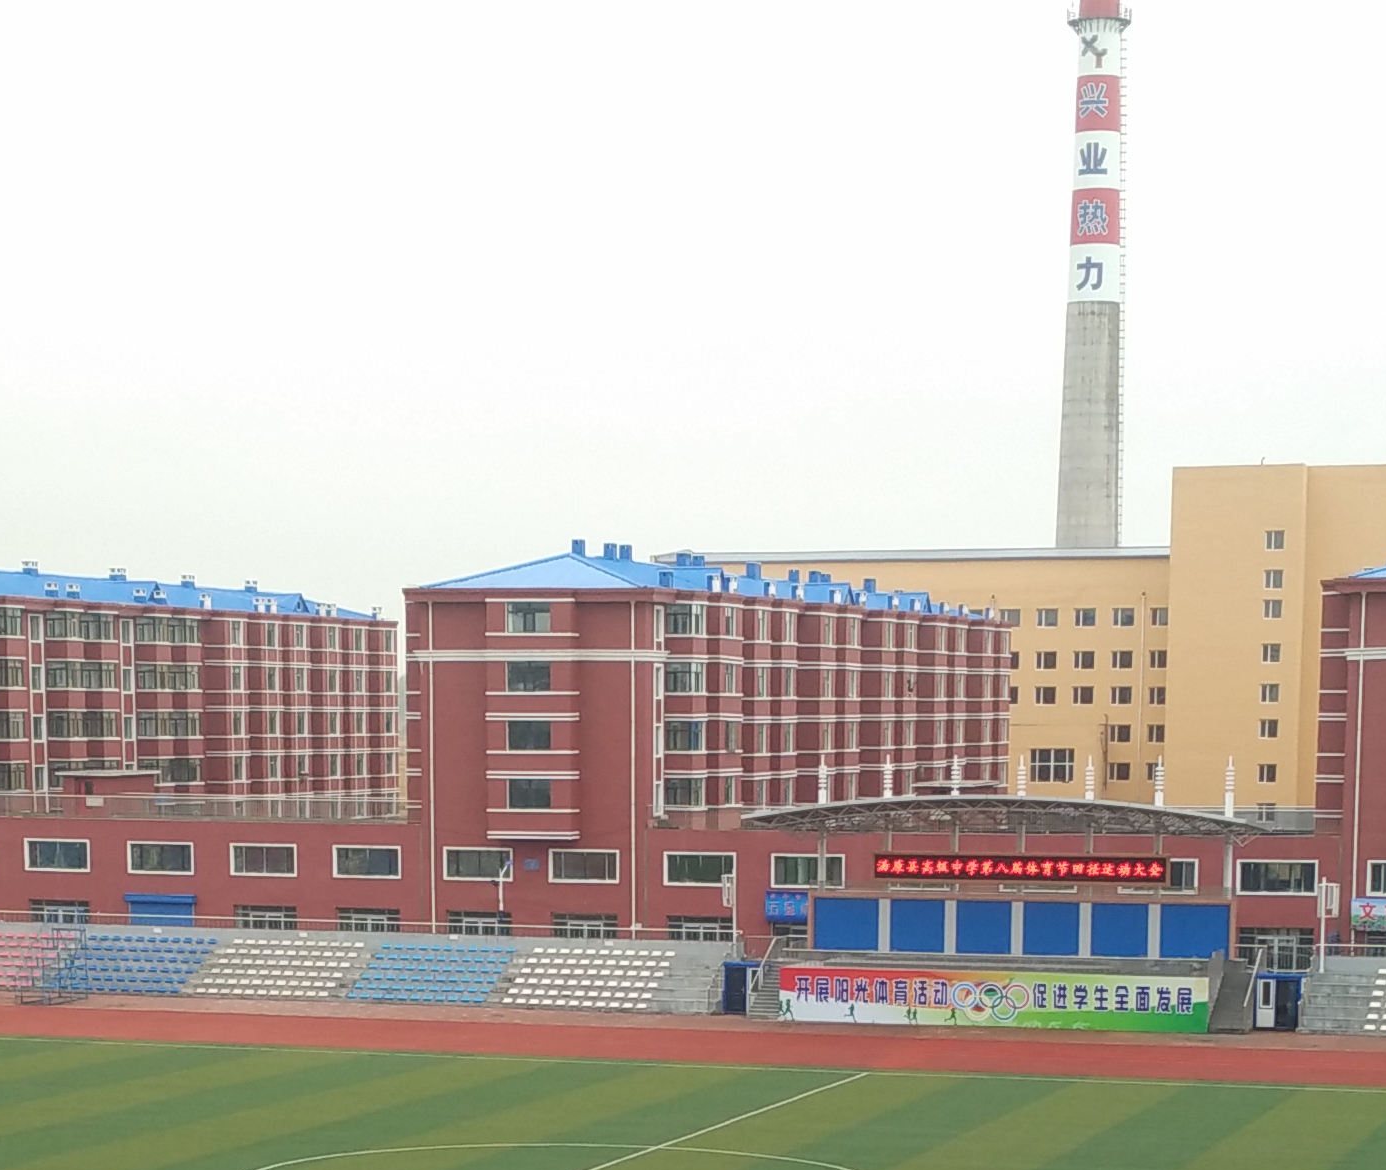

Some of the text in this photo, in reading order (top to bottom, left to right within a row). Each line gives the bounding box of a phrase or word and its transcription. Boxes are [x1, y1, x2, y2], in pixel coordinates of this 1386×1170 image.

[1076, 82, 1108, 291] 兴业热力
[795, 977, 1192, 1013] 开展阳光体育活动 促进学生全面发展
